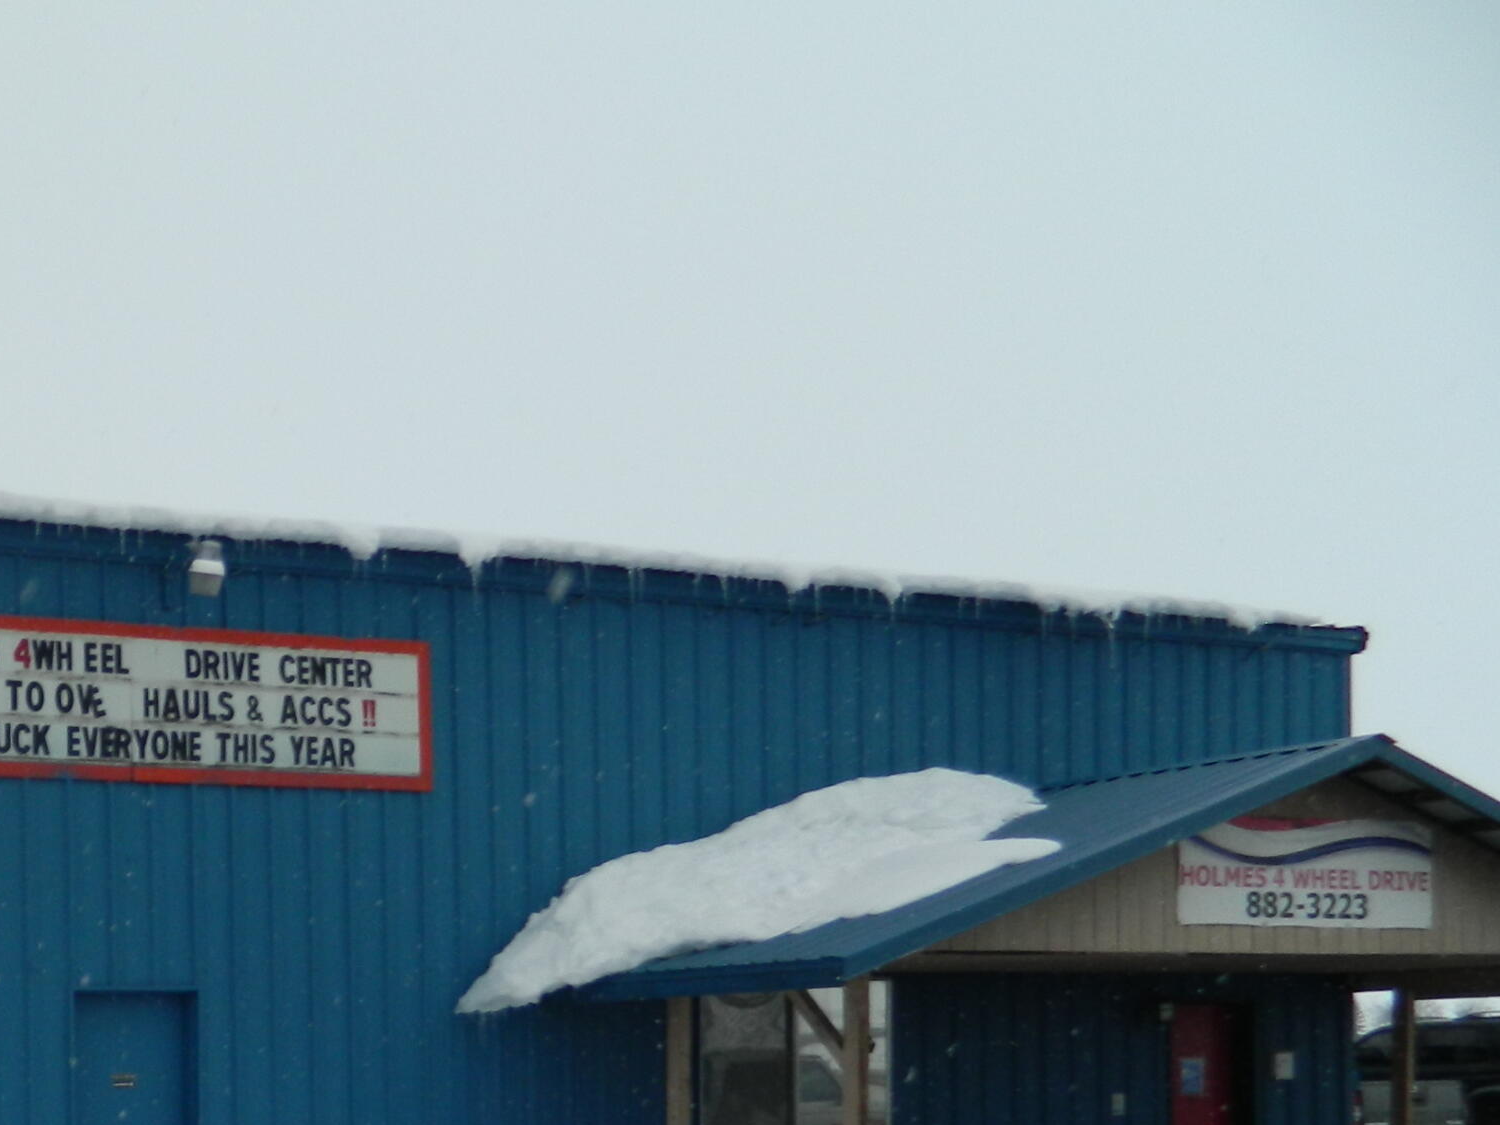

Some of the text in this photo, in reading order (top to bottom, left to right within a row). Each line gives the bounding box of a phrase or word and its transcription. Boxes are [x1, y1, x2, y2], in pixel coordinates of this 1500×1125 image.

[185, 649, 260, 682] DRIVE
[279, 655, 373, 688] CENTER
[6, 680, 45, 711] TO
[143, 687, 235, 722] HAULS
[247, 695, 263, 722] &
[67, 724, 201, 763] EVERYONE
[216, 732, 276, 764] THIS
[290, 735, 355, 768] YEAR
[1179, 864, 1429, 892] HOLMES 4 WHEEL DRIVE
[1246, 891, 1369, 919] 882-3223
